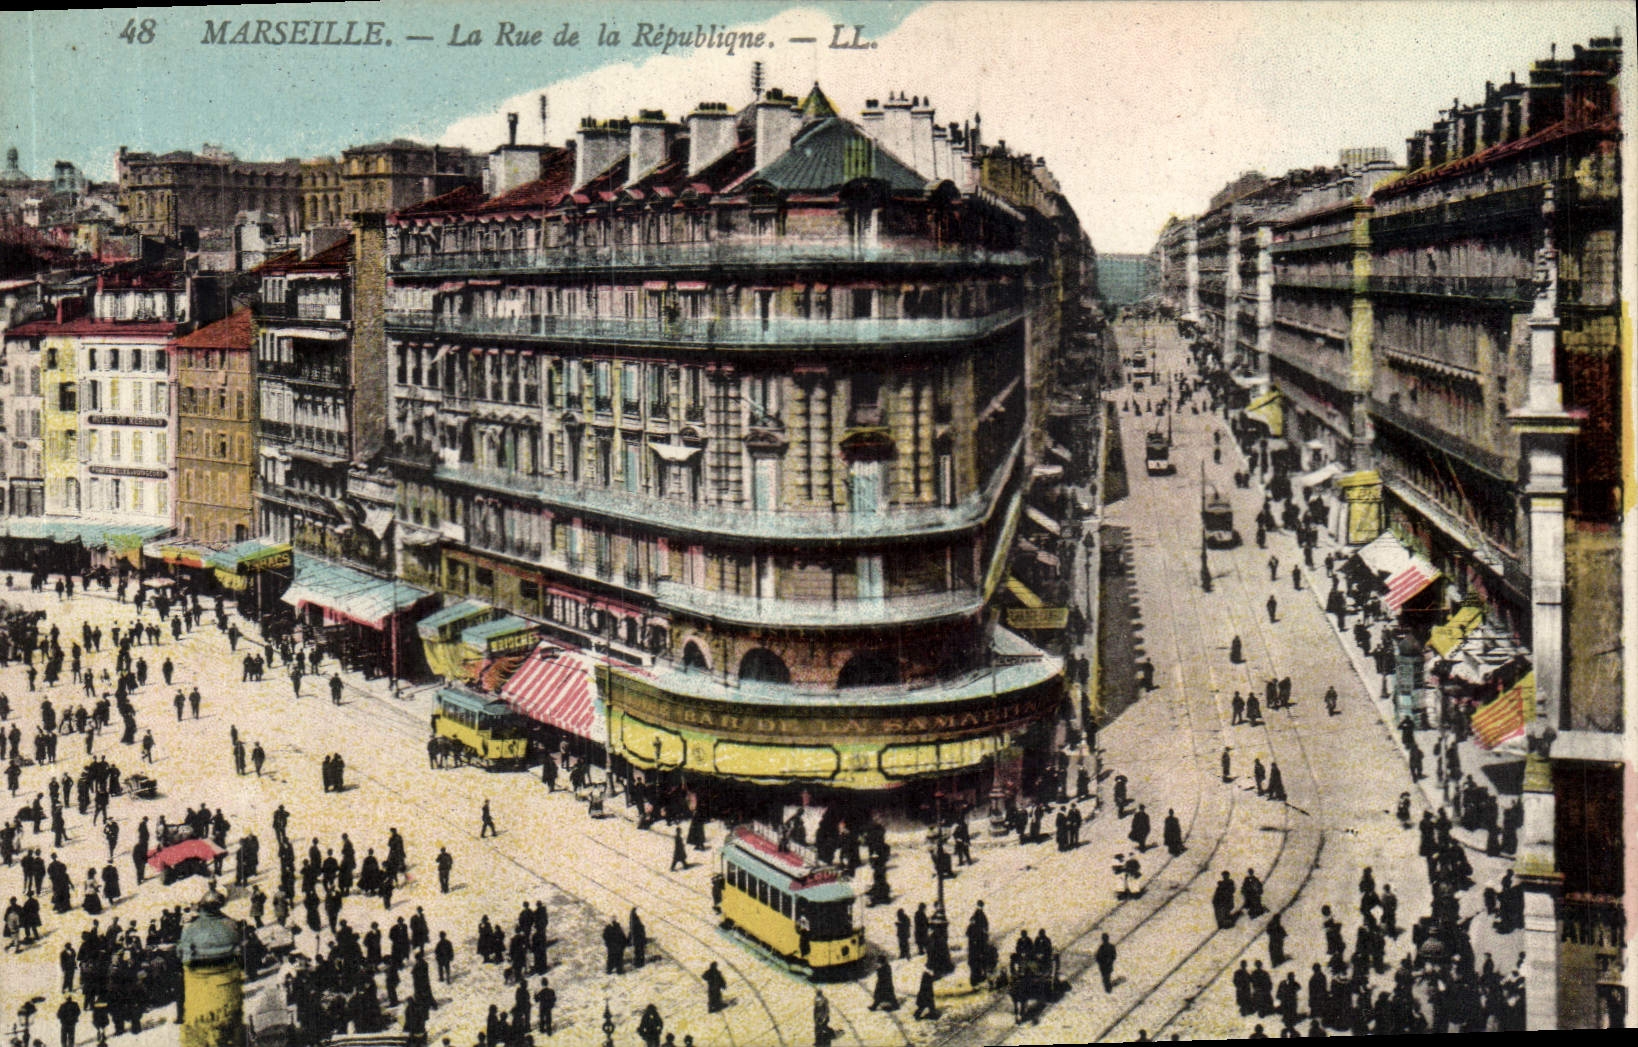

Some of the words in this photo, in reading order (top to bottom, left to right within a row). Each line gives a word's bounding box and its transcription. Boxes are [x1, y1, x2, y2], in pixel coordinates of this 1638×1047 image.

[685, 711, 741, 730] BAR
[757, 718, 797, 733] DE
[821, 718, 868, 733] LA
